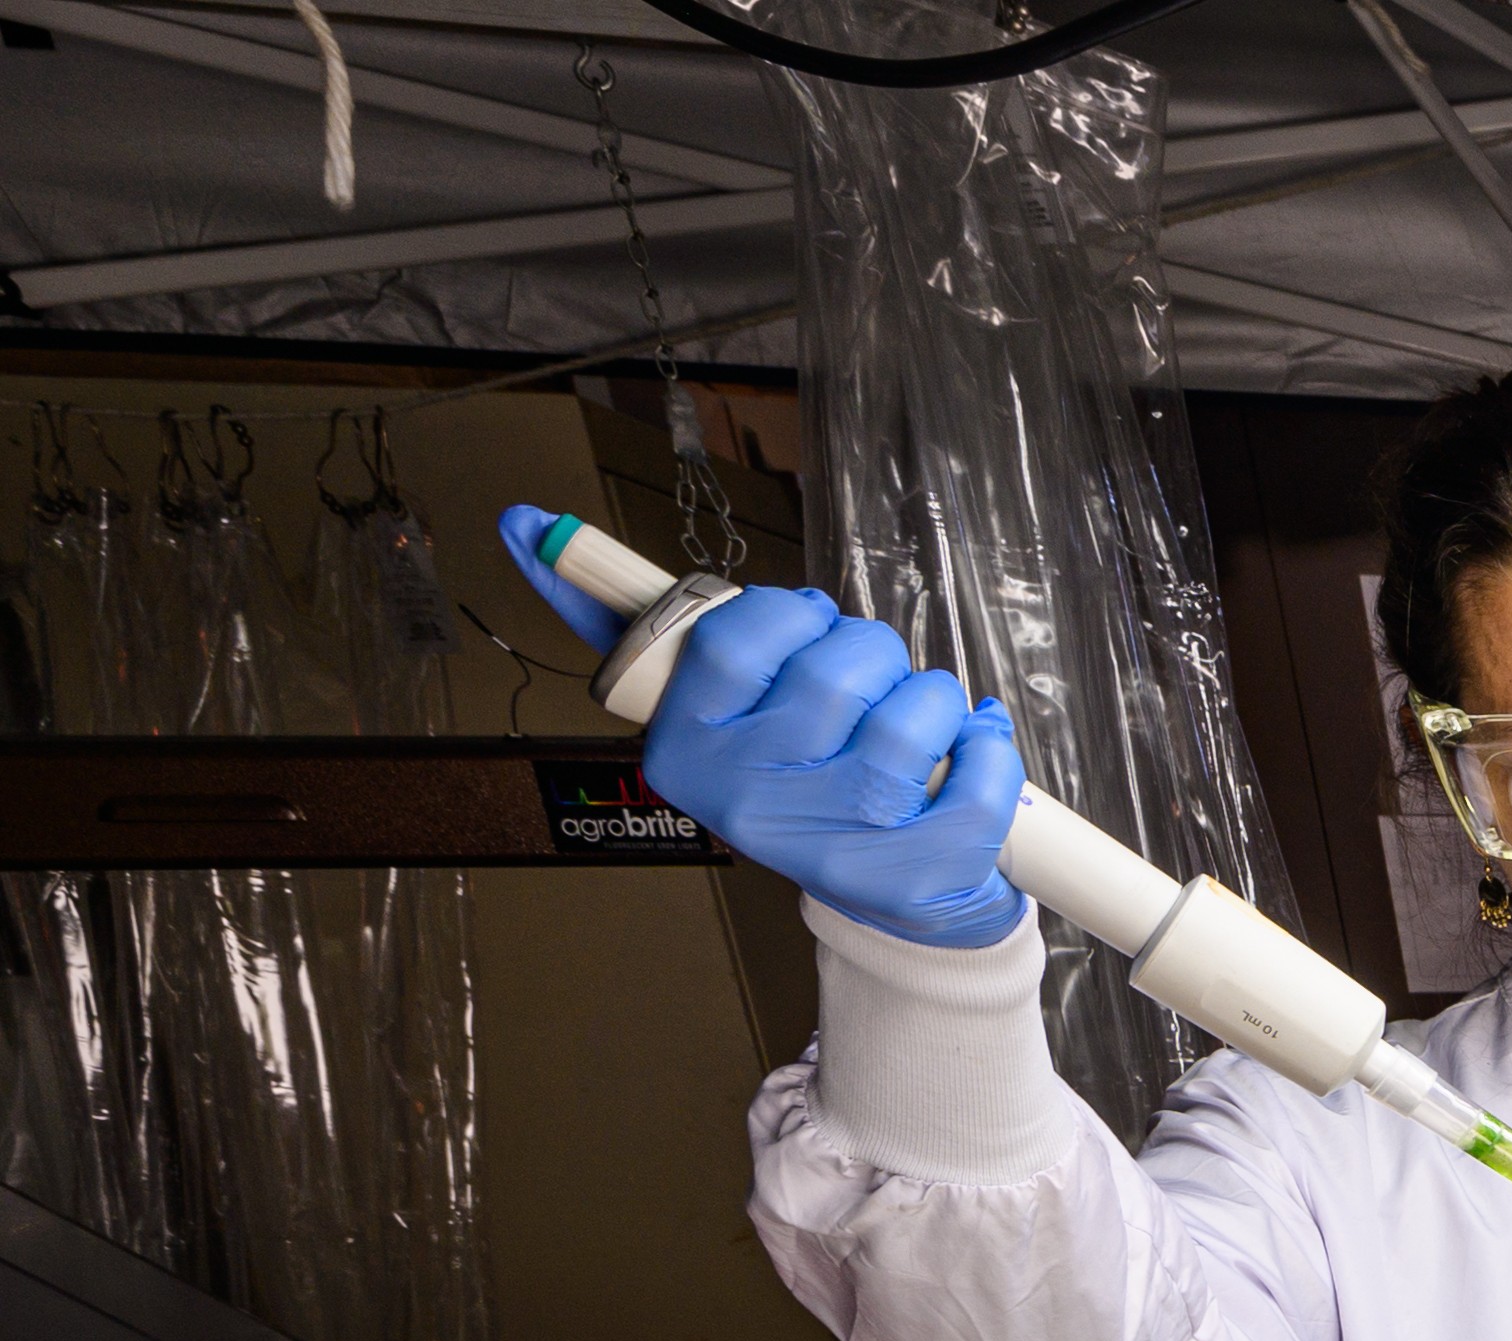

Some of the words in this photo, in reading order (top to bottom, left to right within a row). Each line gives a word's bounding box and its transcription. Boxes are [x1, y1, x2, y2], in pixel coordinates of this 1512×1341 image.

[560, 808, 698, 843] agrobrite
[1242, 1010, 1262, 1027] mL
[1262, 1025, 1279, 1039] 10
